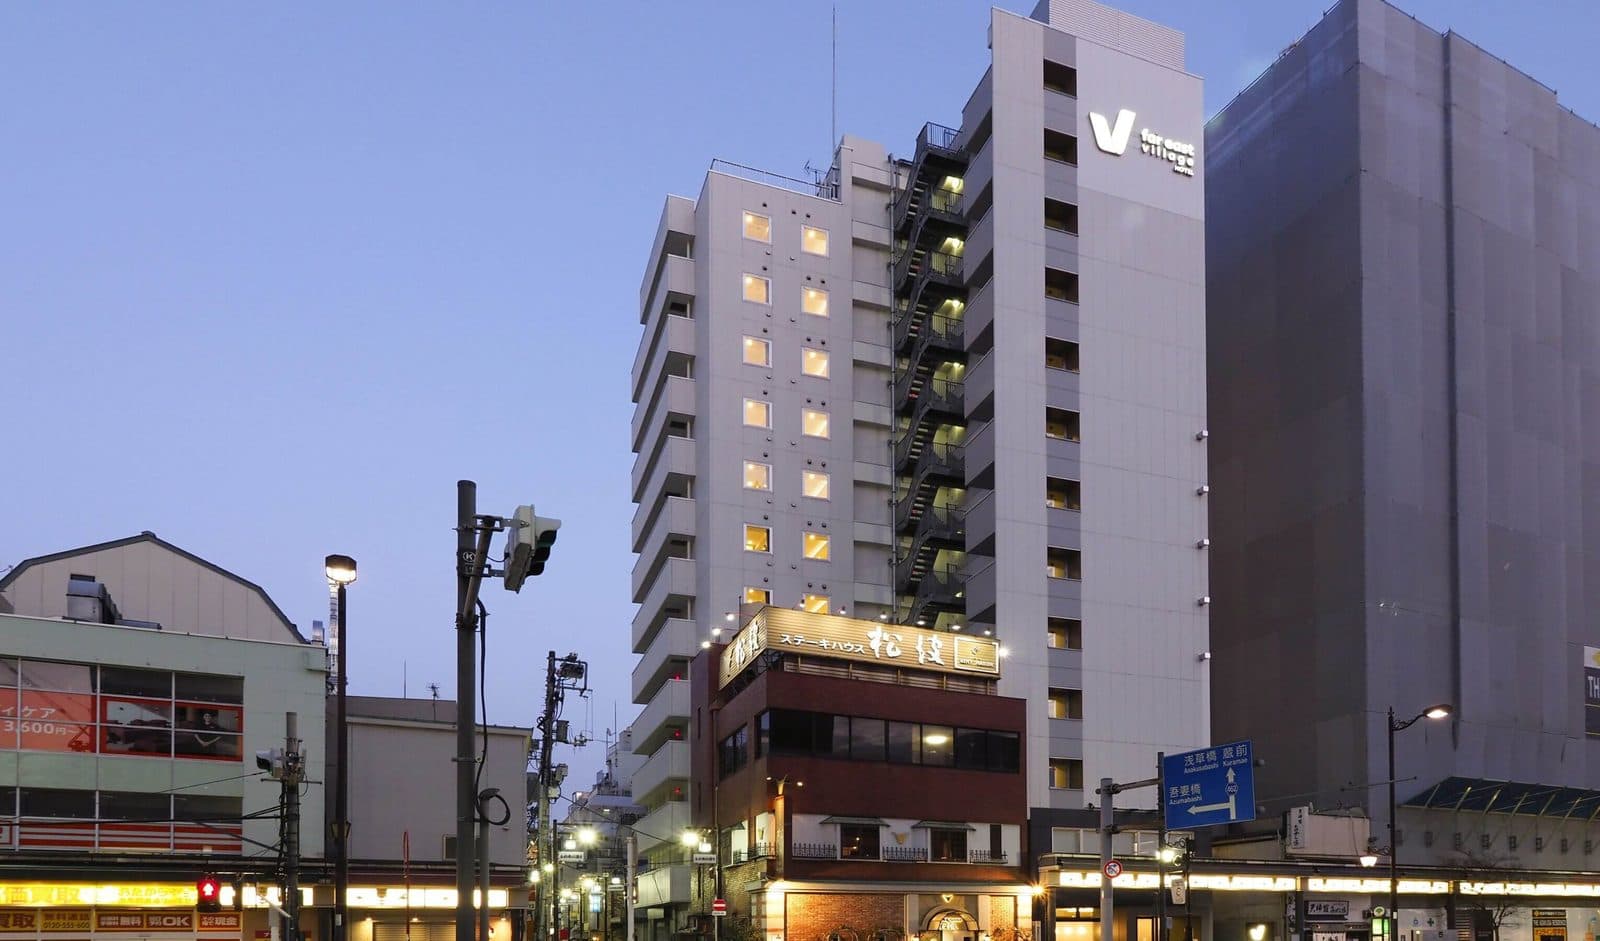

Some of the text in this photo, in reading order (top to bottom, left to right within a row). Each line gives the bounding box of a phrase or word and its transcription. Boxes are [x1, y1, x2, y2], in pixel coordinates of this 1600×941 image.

[1140, 128, 1194, 157] far east
[1141, 144, 1194, 166] village
[1173, 165, 1195, 177] HOTEL
[779, 633, 866, 654] ステーキハウス
[1184, 744, 1248, 766] 浅草橋 蔵前
[1169, 784, 1201, 798] 吾妻橋
[162, 916, 190, 926] OK
